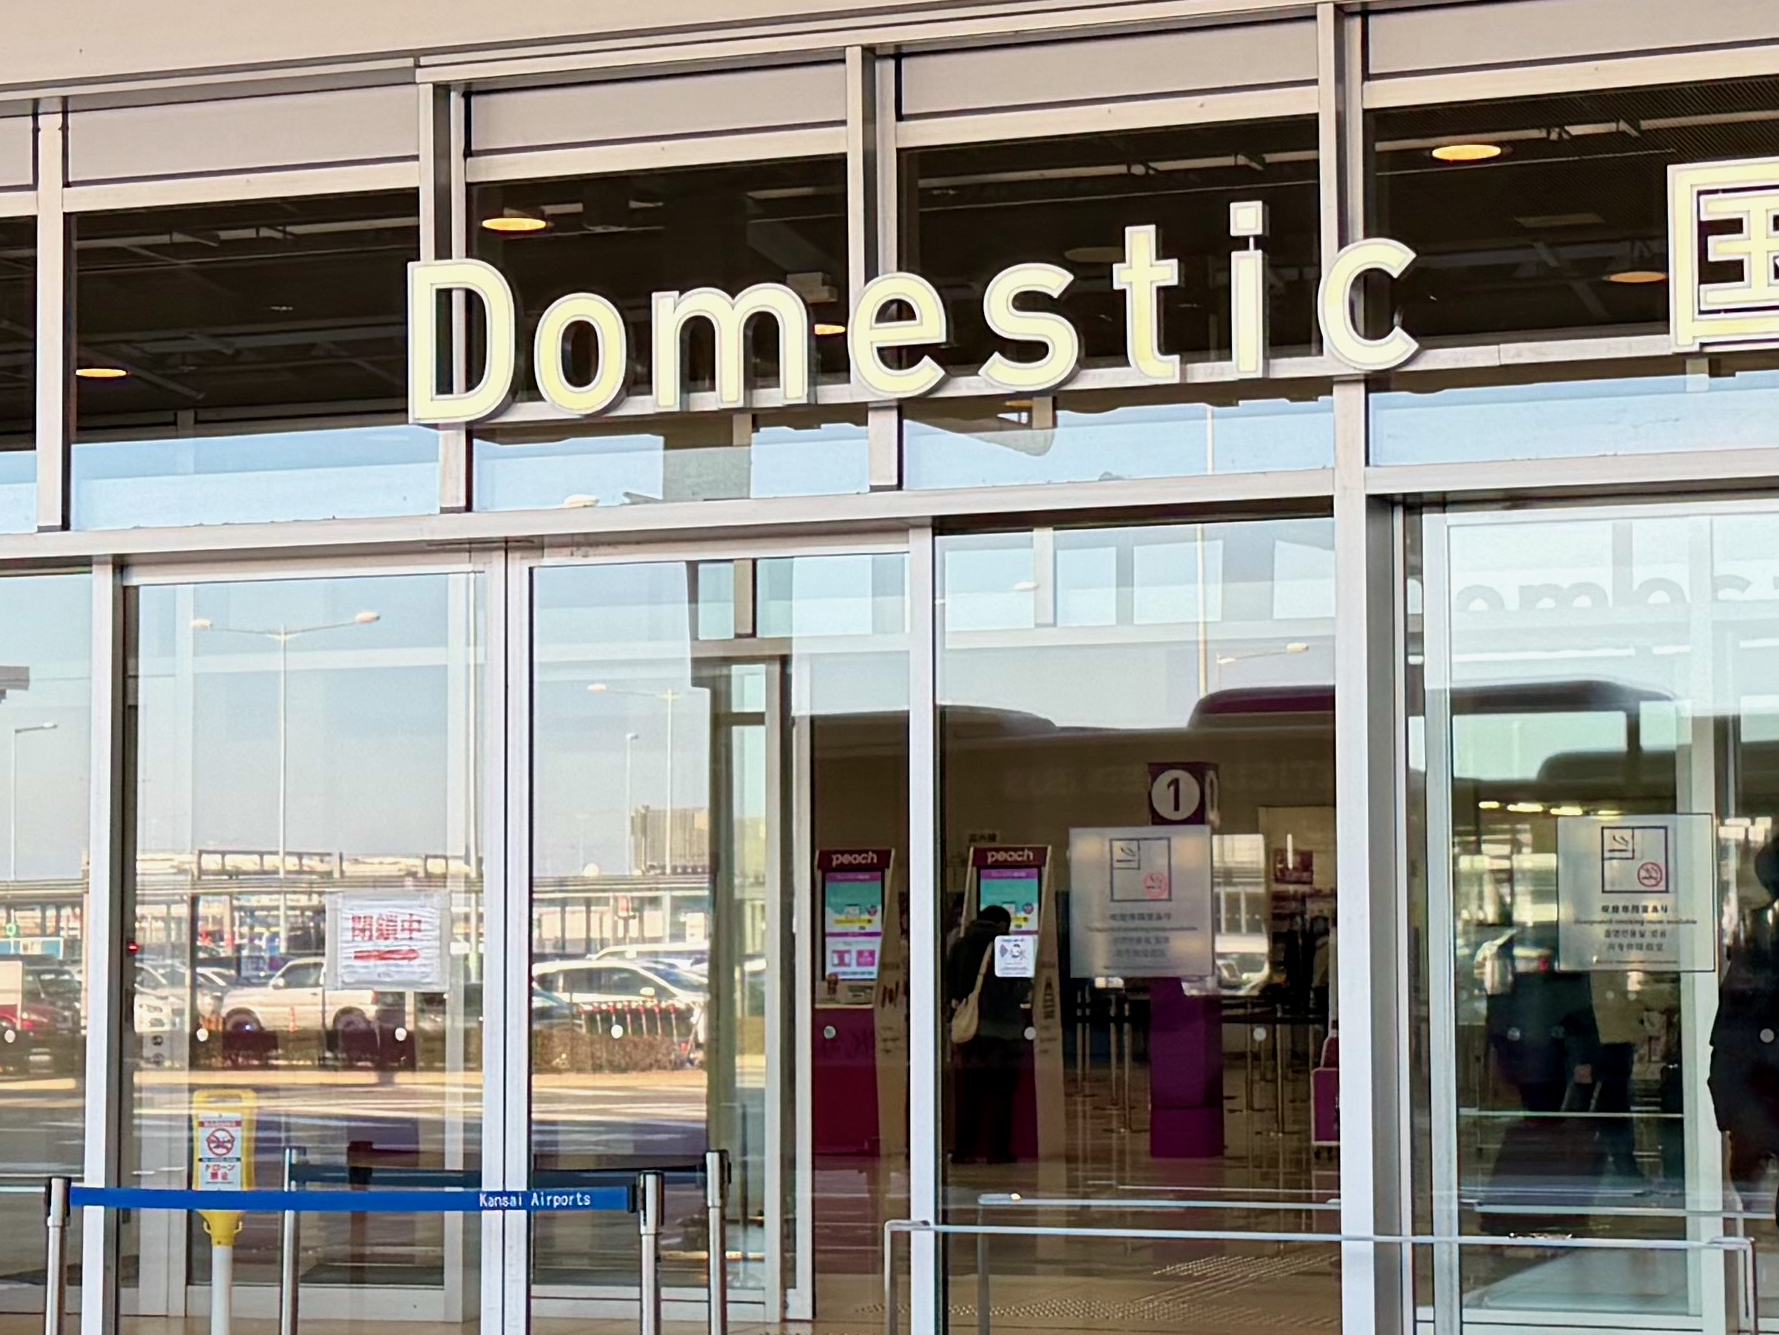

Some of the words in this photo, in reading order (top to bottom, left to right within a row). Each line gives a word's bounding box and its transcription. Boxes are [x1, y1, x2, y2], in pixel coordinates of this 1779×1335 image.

[407, 201, 1418, 423] Domestic
[1167, 777, 1181, 812] 1
[831, 850, 878, 867] peach
[987, 848, 1034, 865] peach
[351, 913, 423, 942] 閉鎖中
[479, 1193, 522, 1207] Kansai
[531, 1192, 591, 1208] Airports
